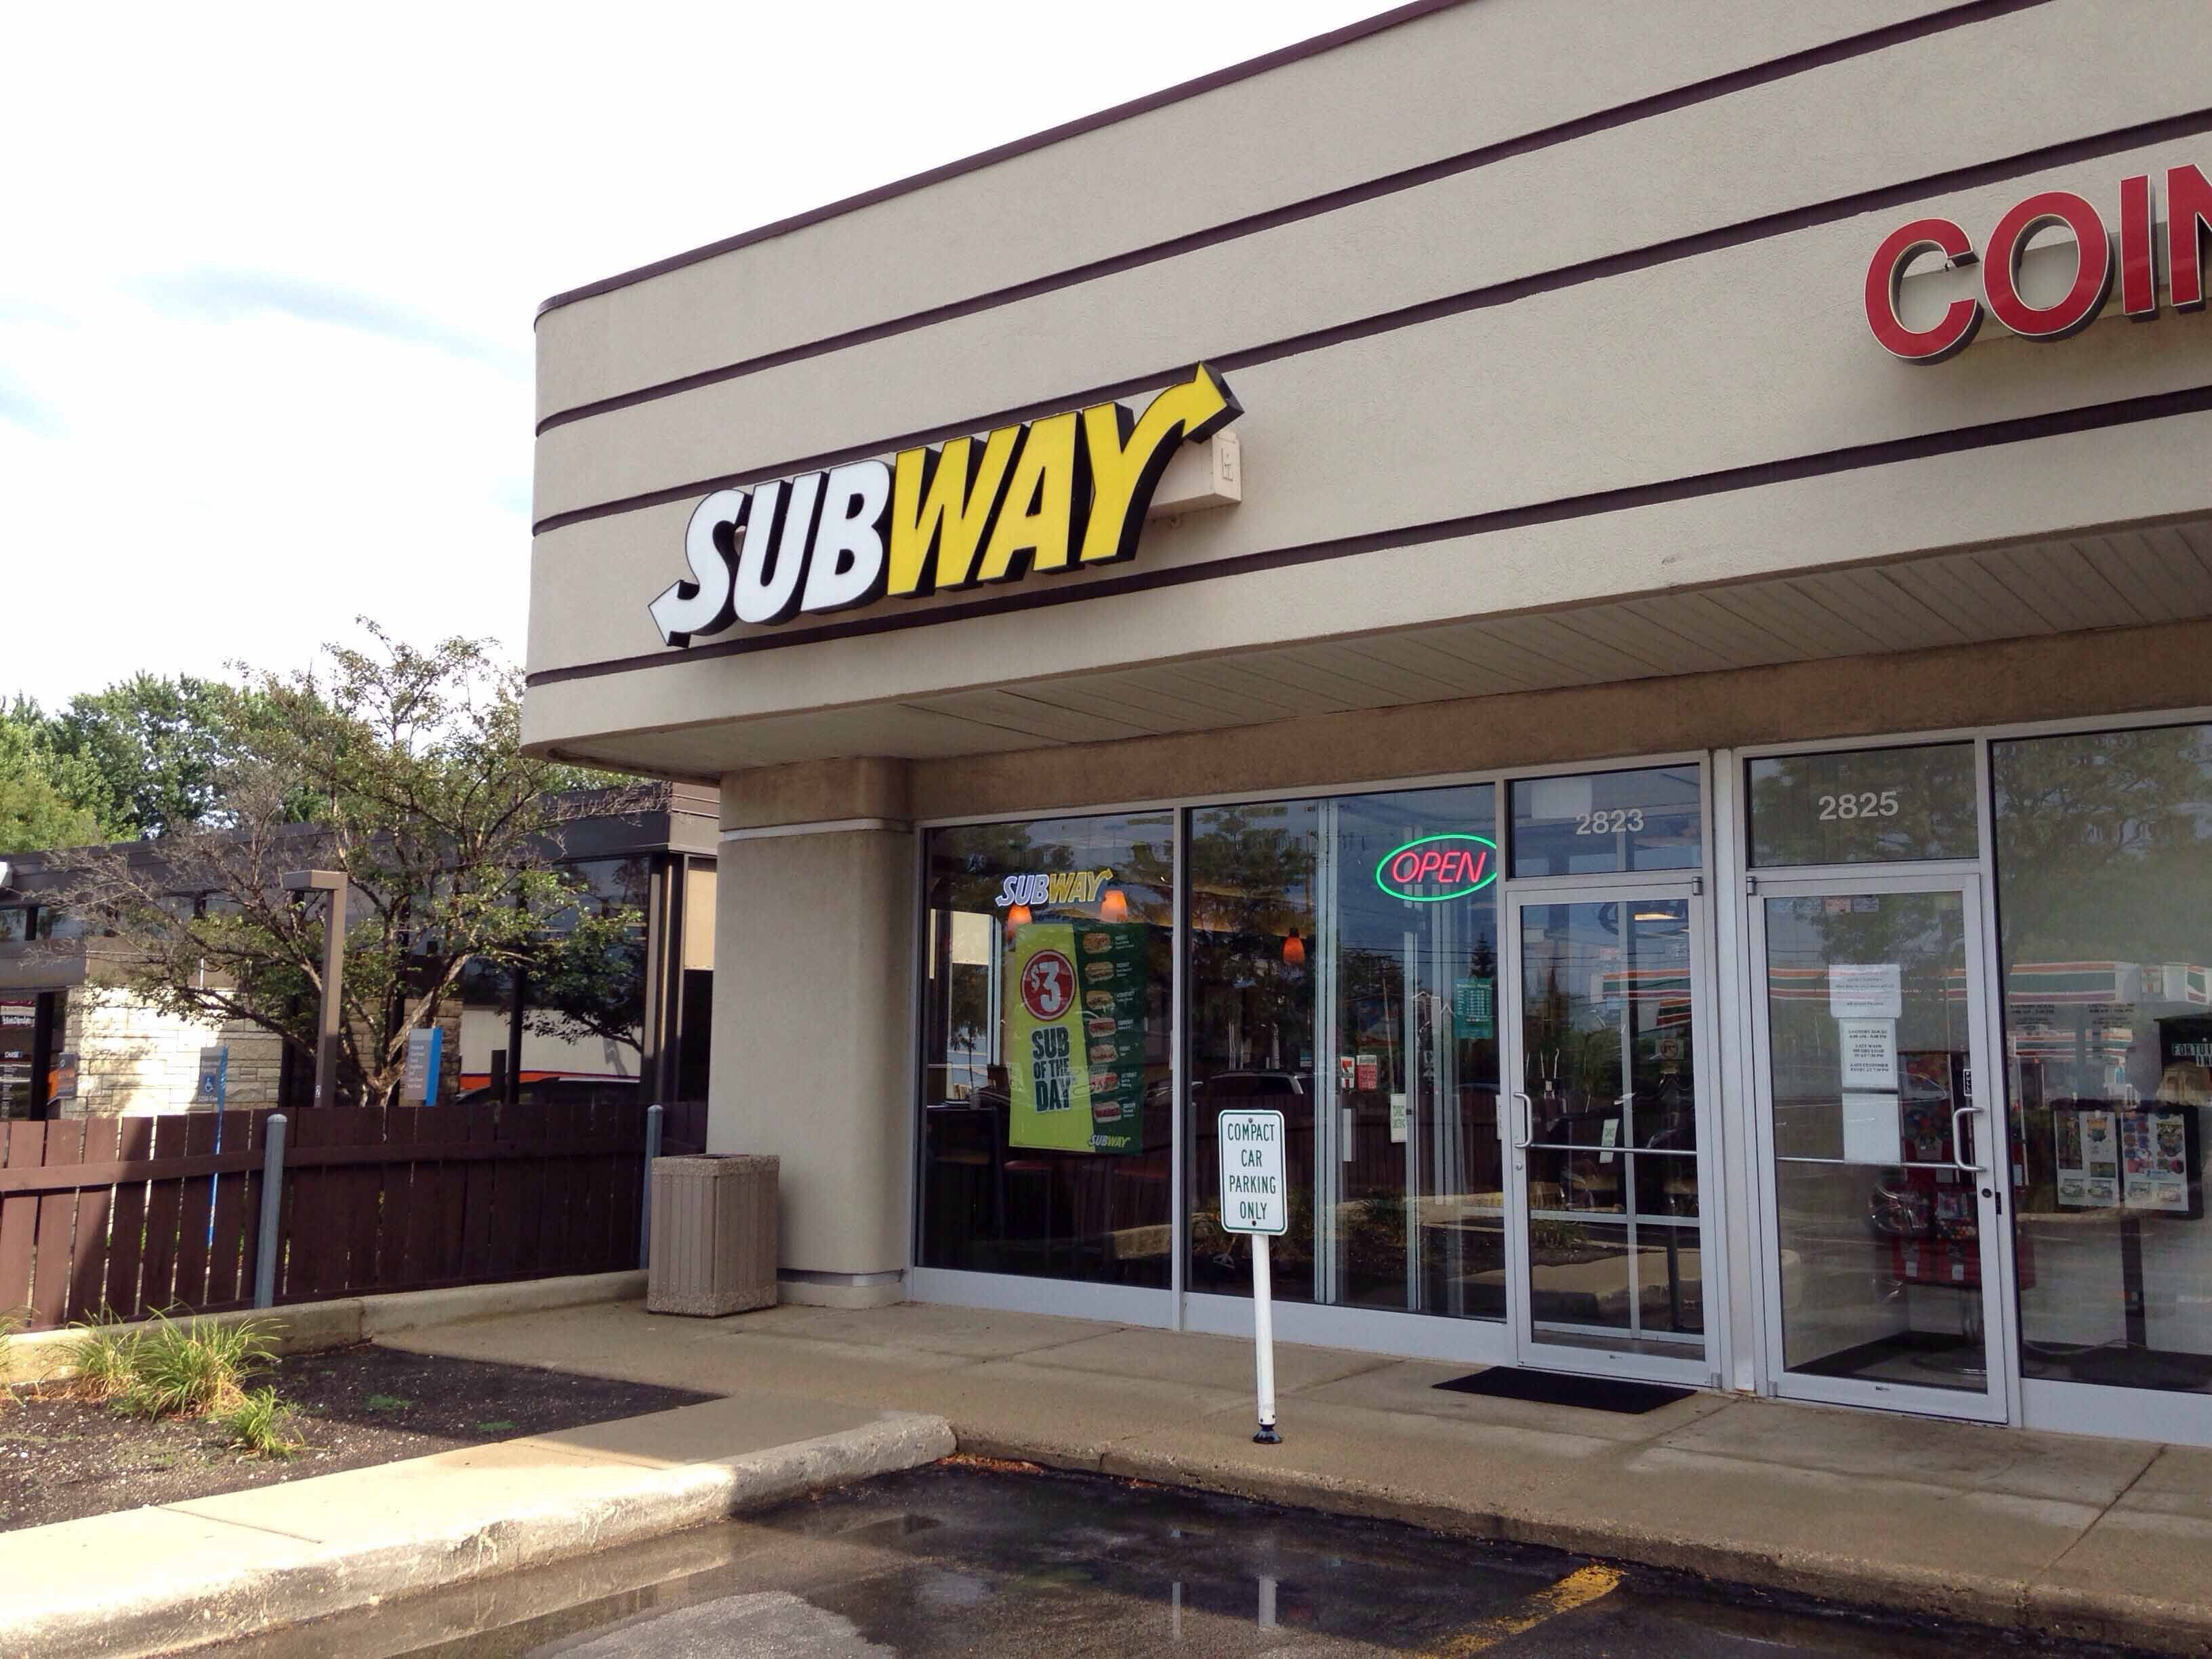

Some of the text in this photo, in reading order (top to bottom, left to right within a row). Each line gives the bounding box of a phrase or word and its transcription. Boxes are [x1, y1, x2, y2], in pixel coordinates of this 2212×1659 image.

[649, 361, 1244, 647] SUBWAY
[1818, 791, 1898, 821] 2825
[1575, 808, 1645, 836] 2823
[1391, 851, 1486, 883] OPEN
[995, 868, 1113, 907] SUBWAY
[1030, 961, 1061, 1012] $3
[1031, 1026, 1070, 1059] SUB
[1033, 1058, 1070, 1080] OF THE
[1035, 1080, 1071, 1111] DAY
[1088, 1134, 1131, 1148] SUBWAY
[1227, 1122, 1275, 1142] COMPACT
[1241, 1149, 1263, 1168] CAR
[1229, 1174, 1276, 1194] PARKING
[1240, 1200, 1267, 1220] ONLY
